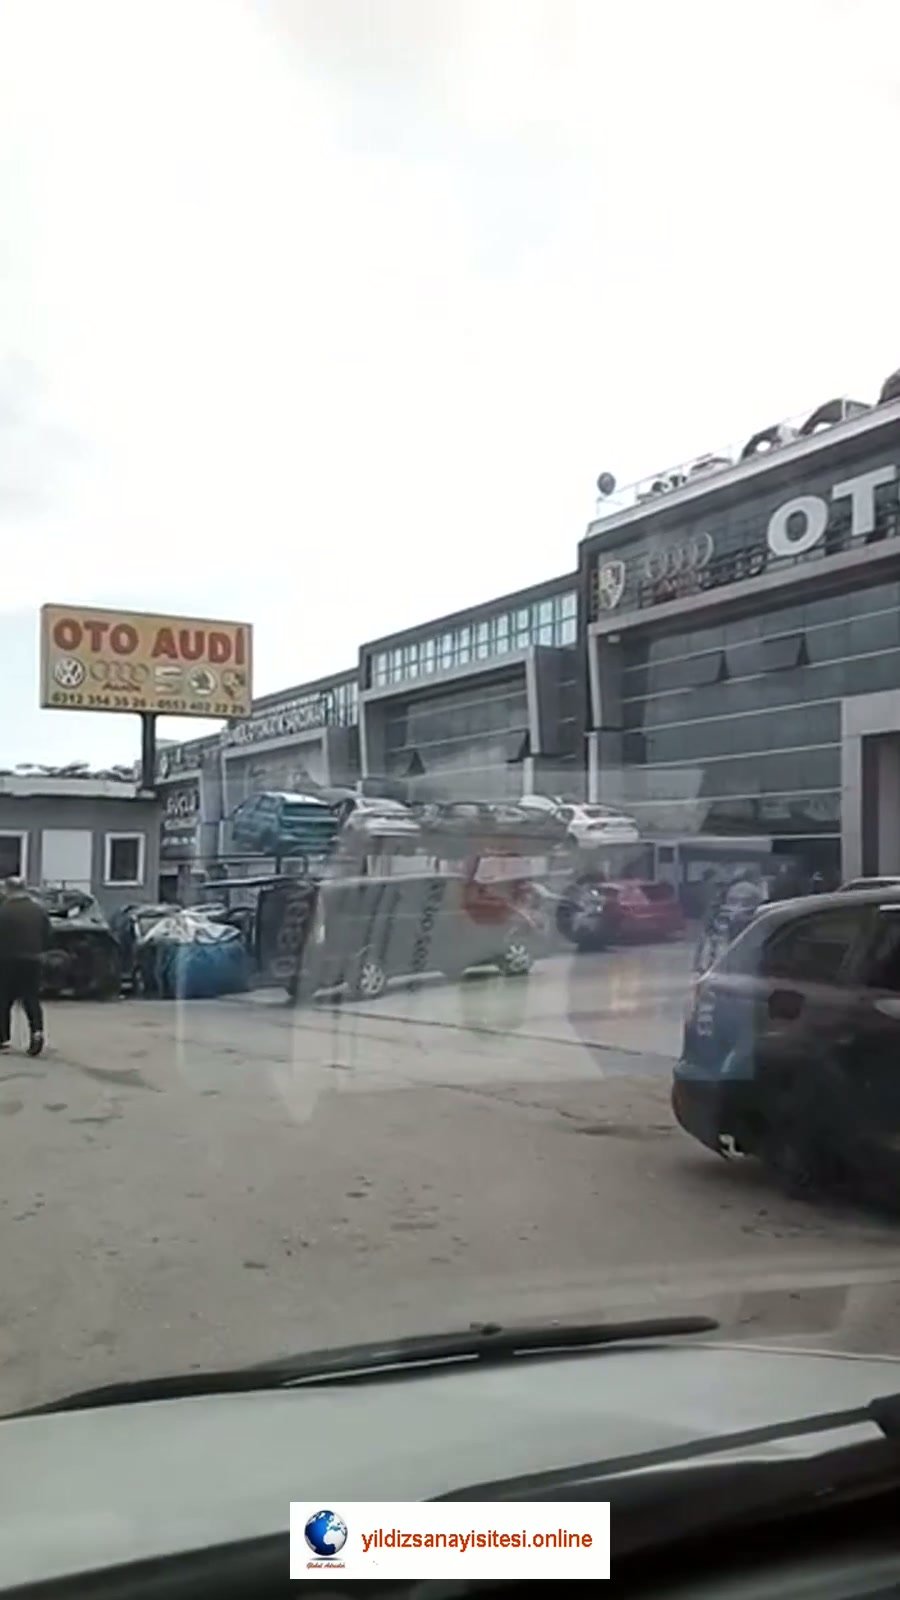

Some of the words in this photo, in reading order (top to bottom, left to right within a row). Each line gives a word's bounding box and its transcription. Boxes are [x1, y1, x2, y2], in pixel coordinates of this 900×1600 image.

[766, 465, 900, 556] OT
[53, 618, 139, 655] OTO
[151, 627, 245, 665] AUDİ
